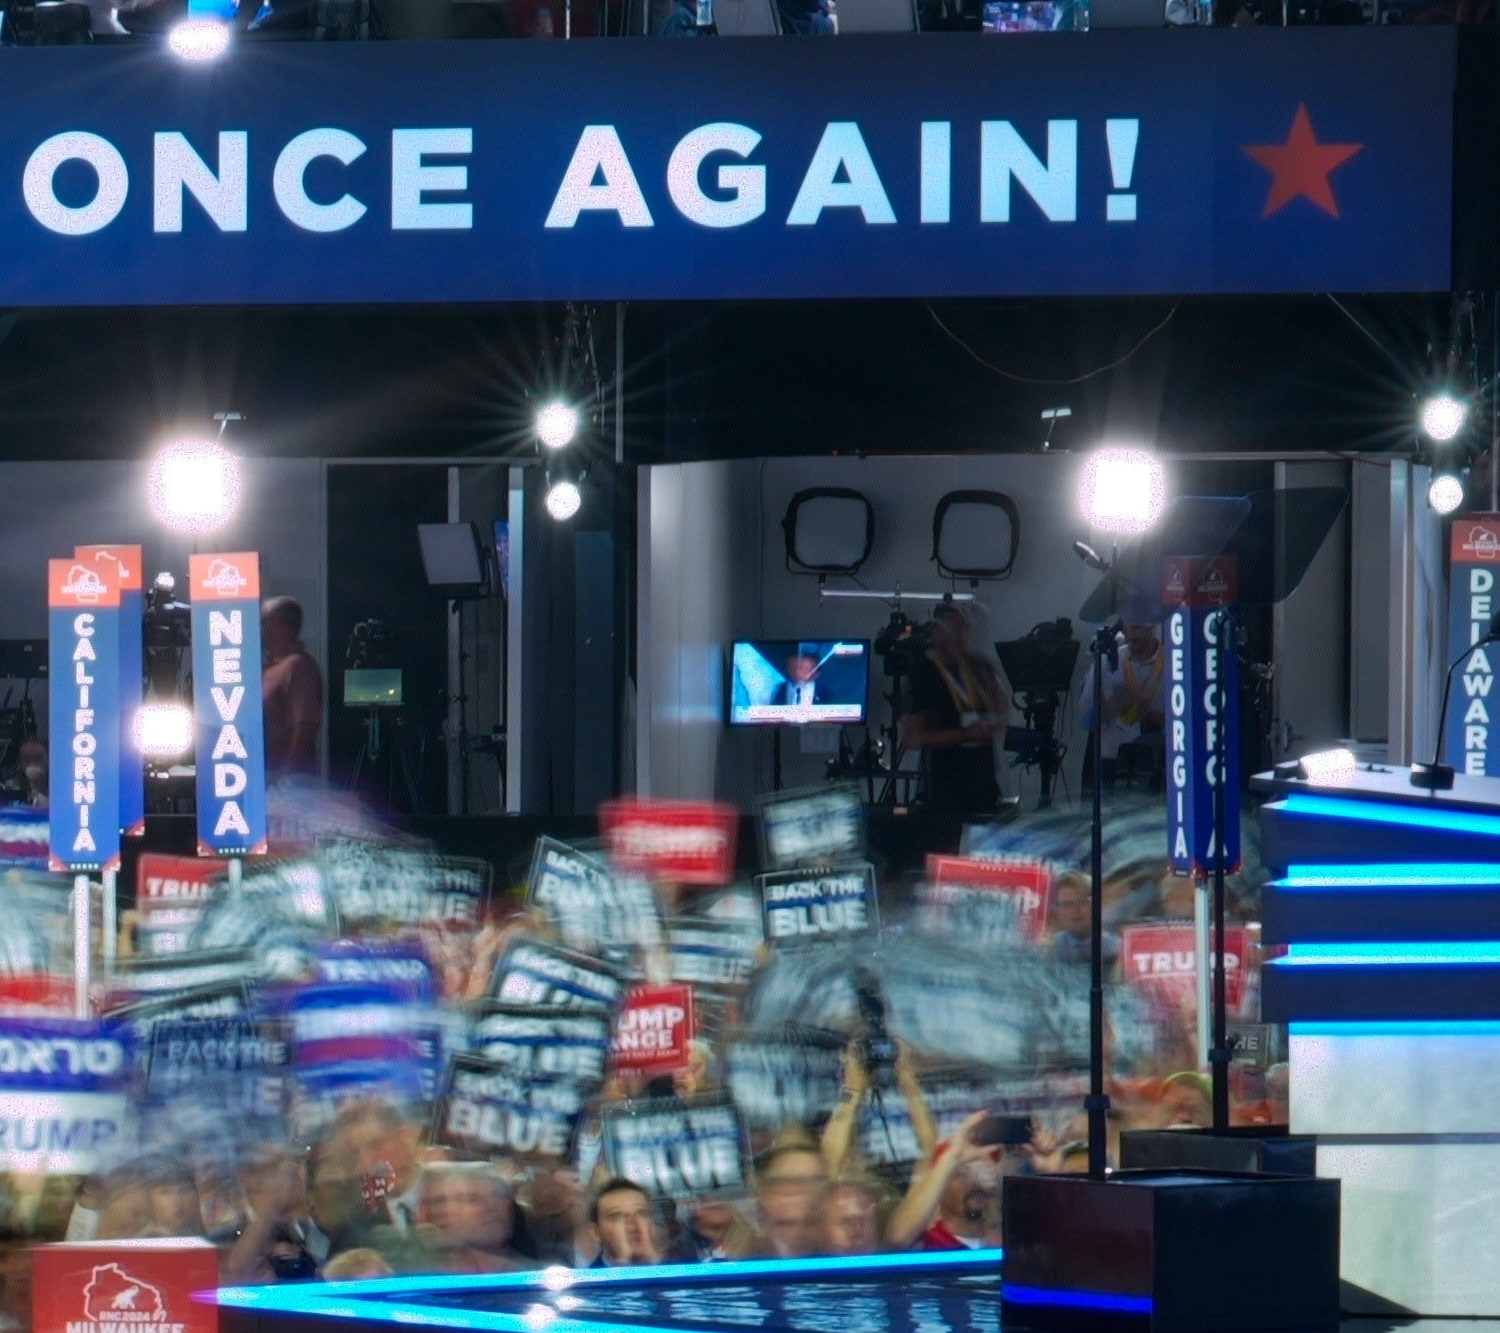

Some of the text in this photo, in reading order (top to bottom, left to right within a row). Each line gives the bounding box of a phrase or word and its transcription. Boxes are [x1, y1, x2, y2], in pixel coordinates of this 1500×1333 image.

[20, 126, 476, 238] ONCE
[543, 117, 1141, 231] AGAIN!
[72, 613, 98, 853] CALIFORNIA
[209, 611, 251, 836] NEVADA
[1170, 612, 1188, 860] GEORGIA
[771, 878, 869, 902] BACK THE
[772, 899, 868, 937] BLUE
[1133, 951, 1240, 974] TRUP
[168, 1037, 288, 1066] BACK THE
[447, 1102, 572, 1153] BLUE
[618, 1141, 742, 1194] BLUE
